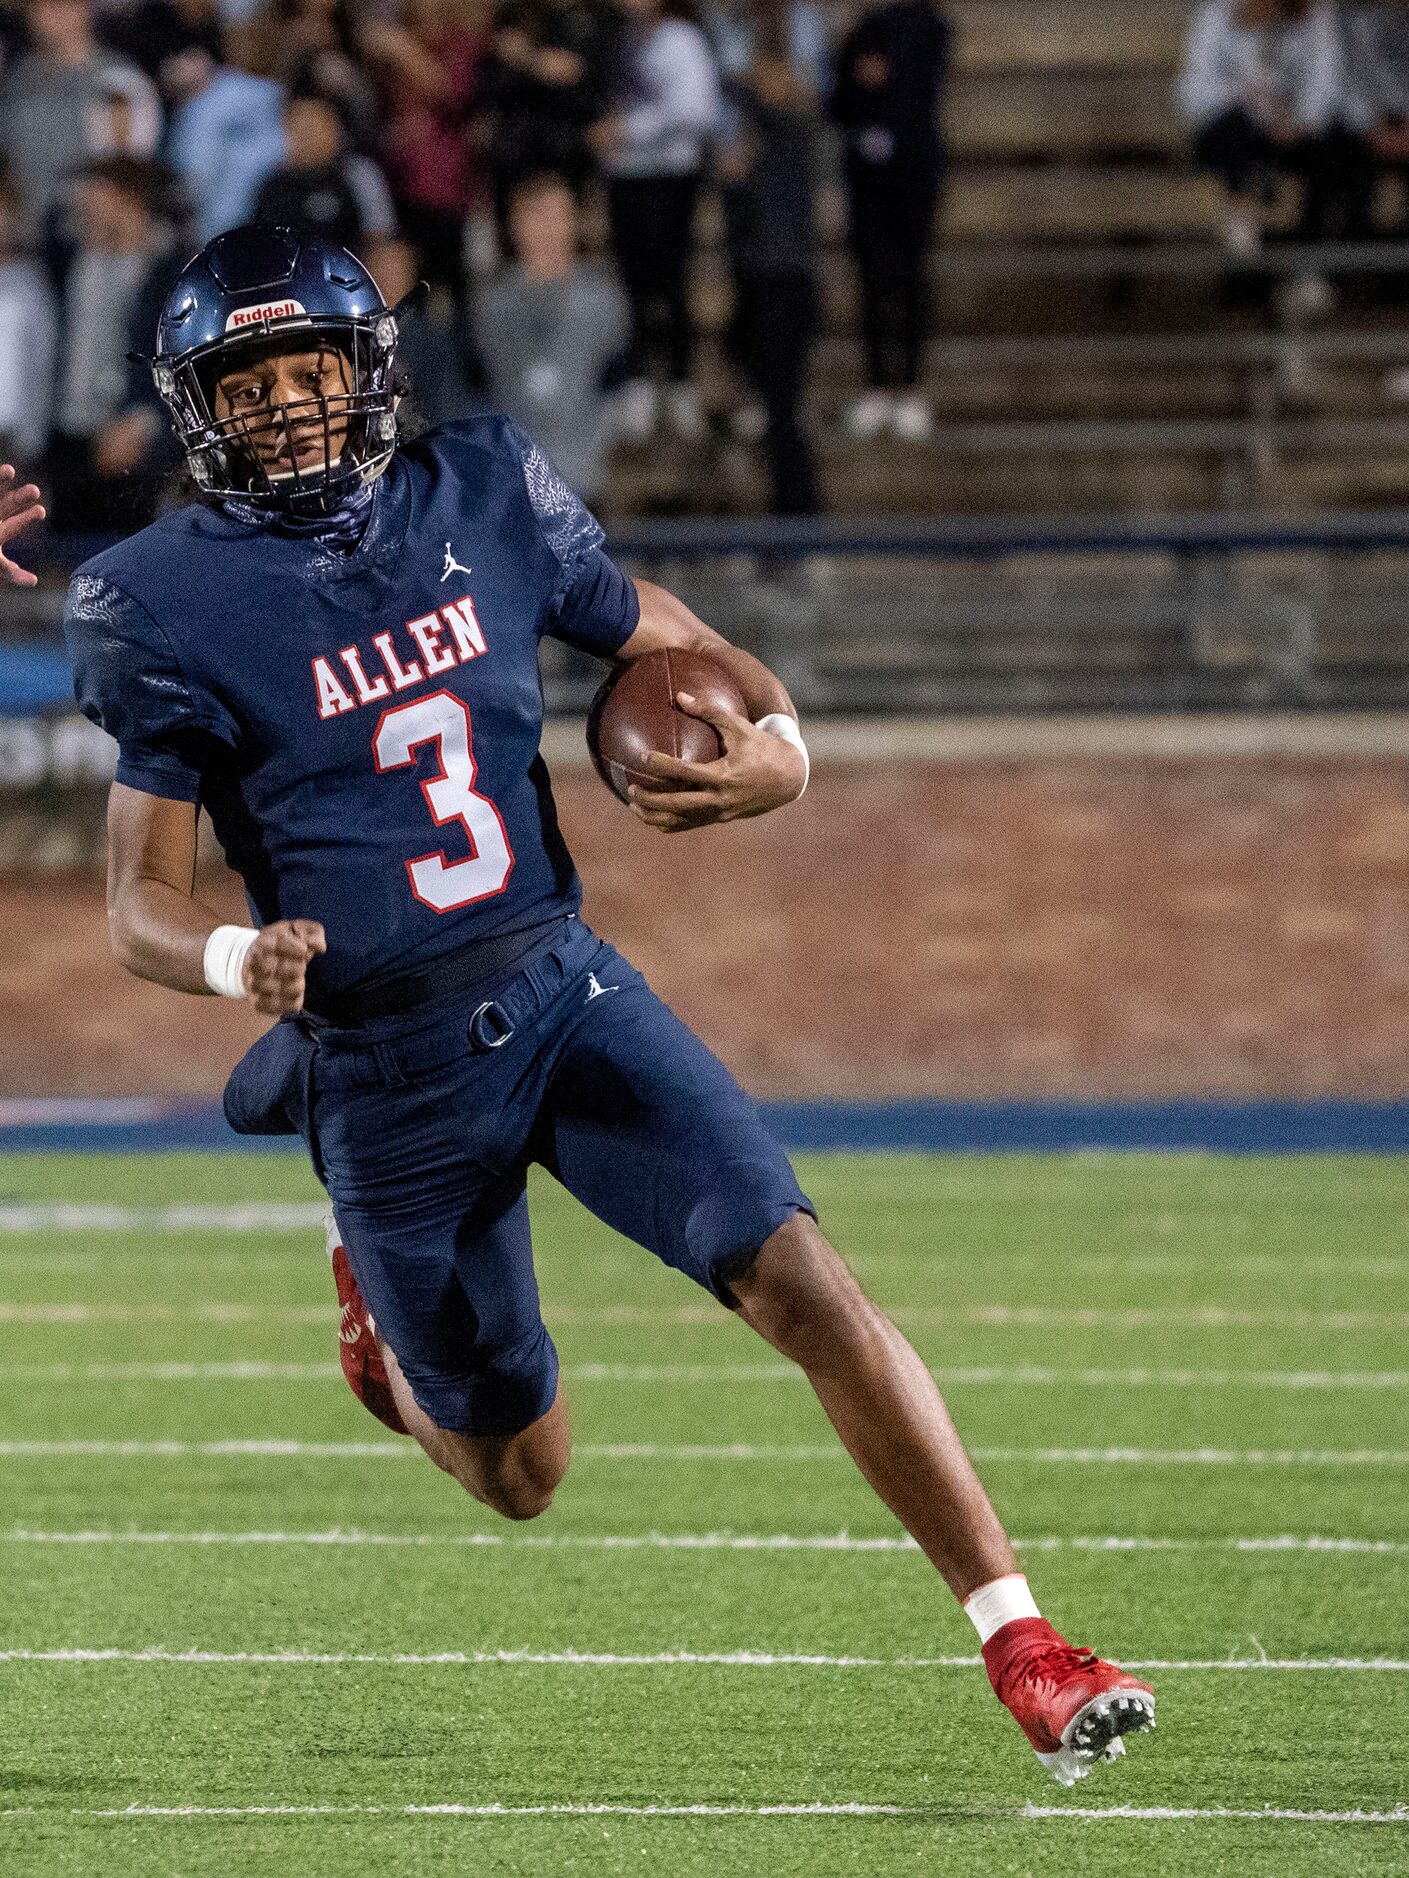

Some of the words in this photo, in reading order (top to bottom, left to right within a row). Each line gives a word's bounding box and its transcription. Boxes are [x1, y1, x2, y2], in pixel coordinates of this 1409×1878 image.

[233, 303, 296, 326] Riddell
[311, 595, 488, 720] ALLEN
[371, 688, 516, 915] 3
